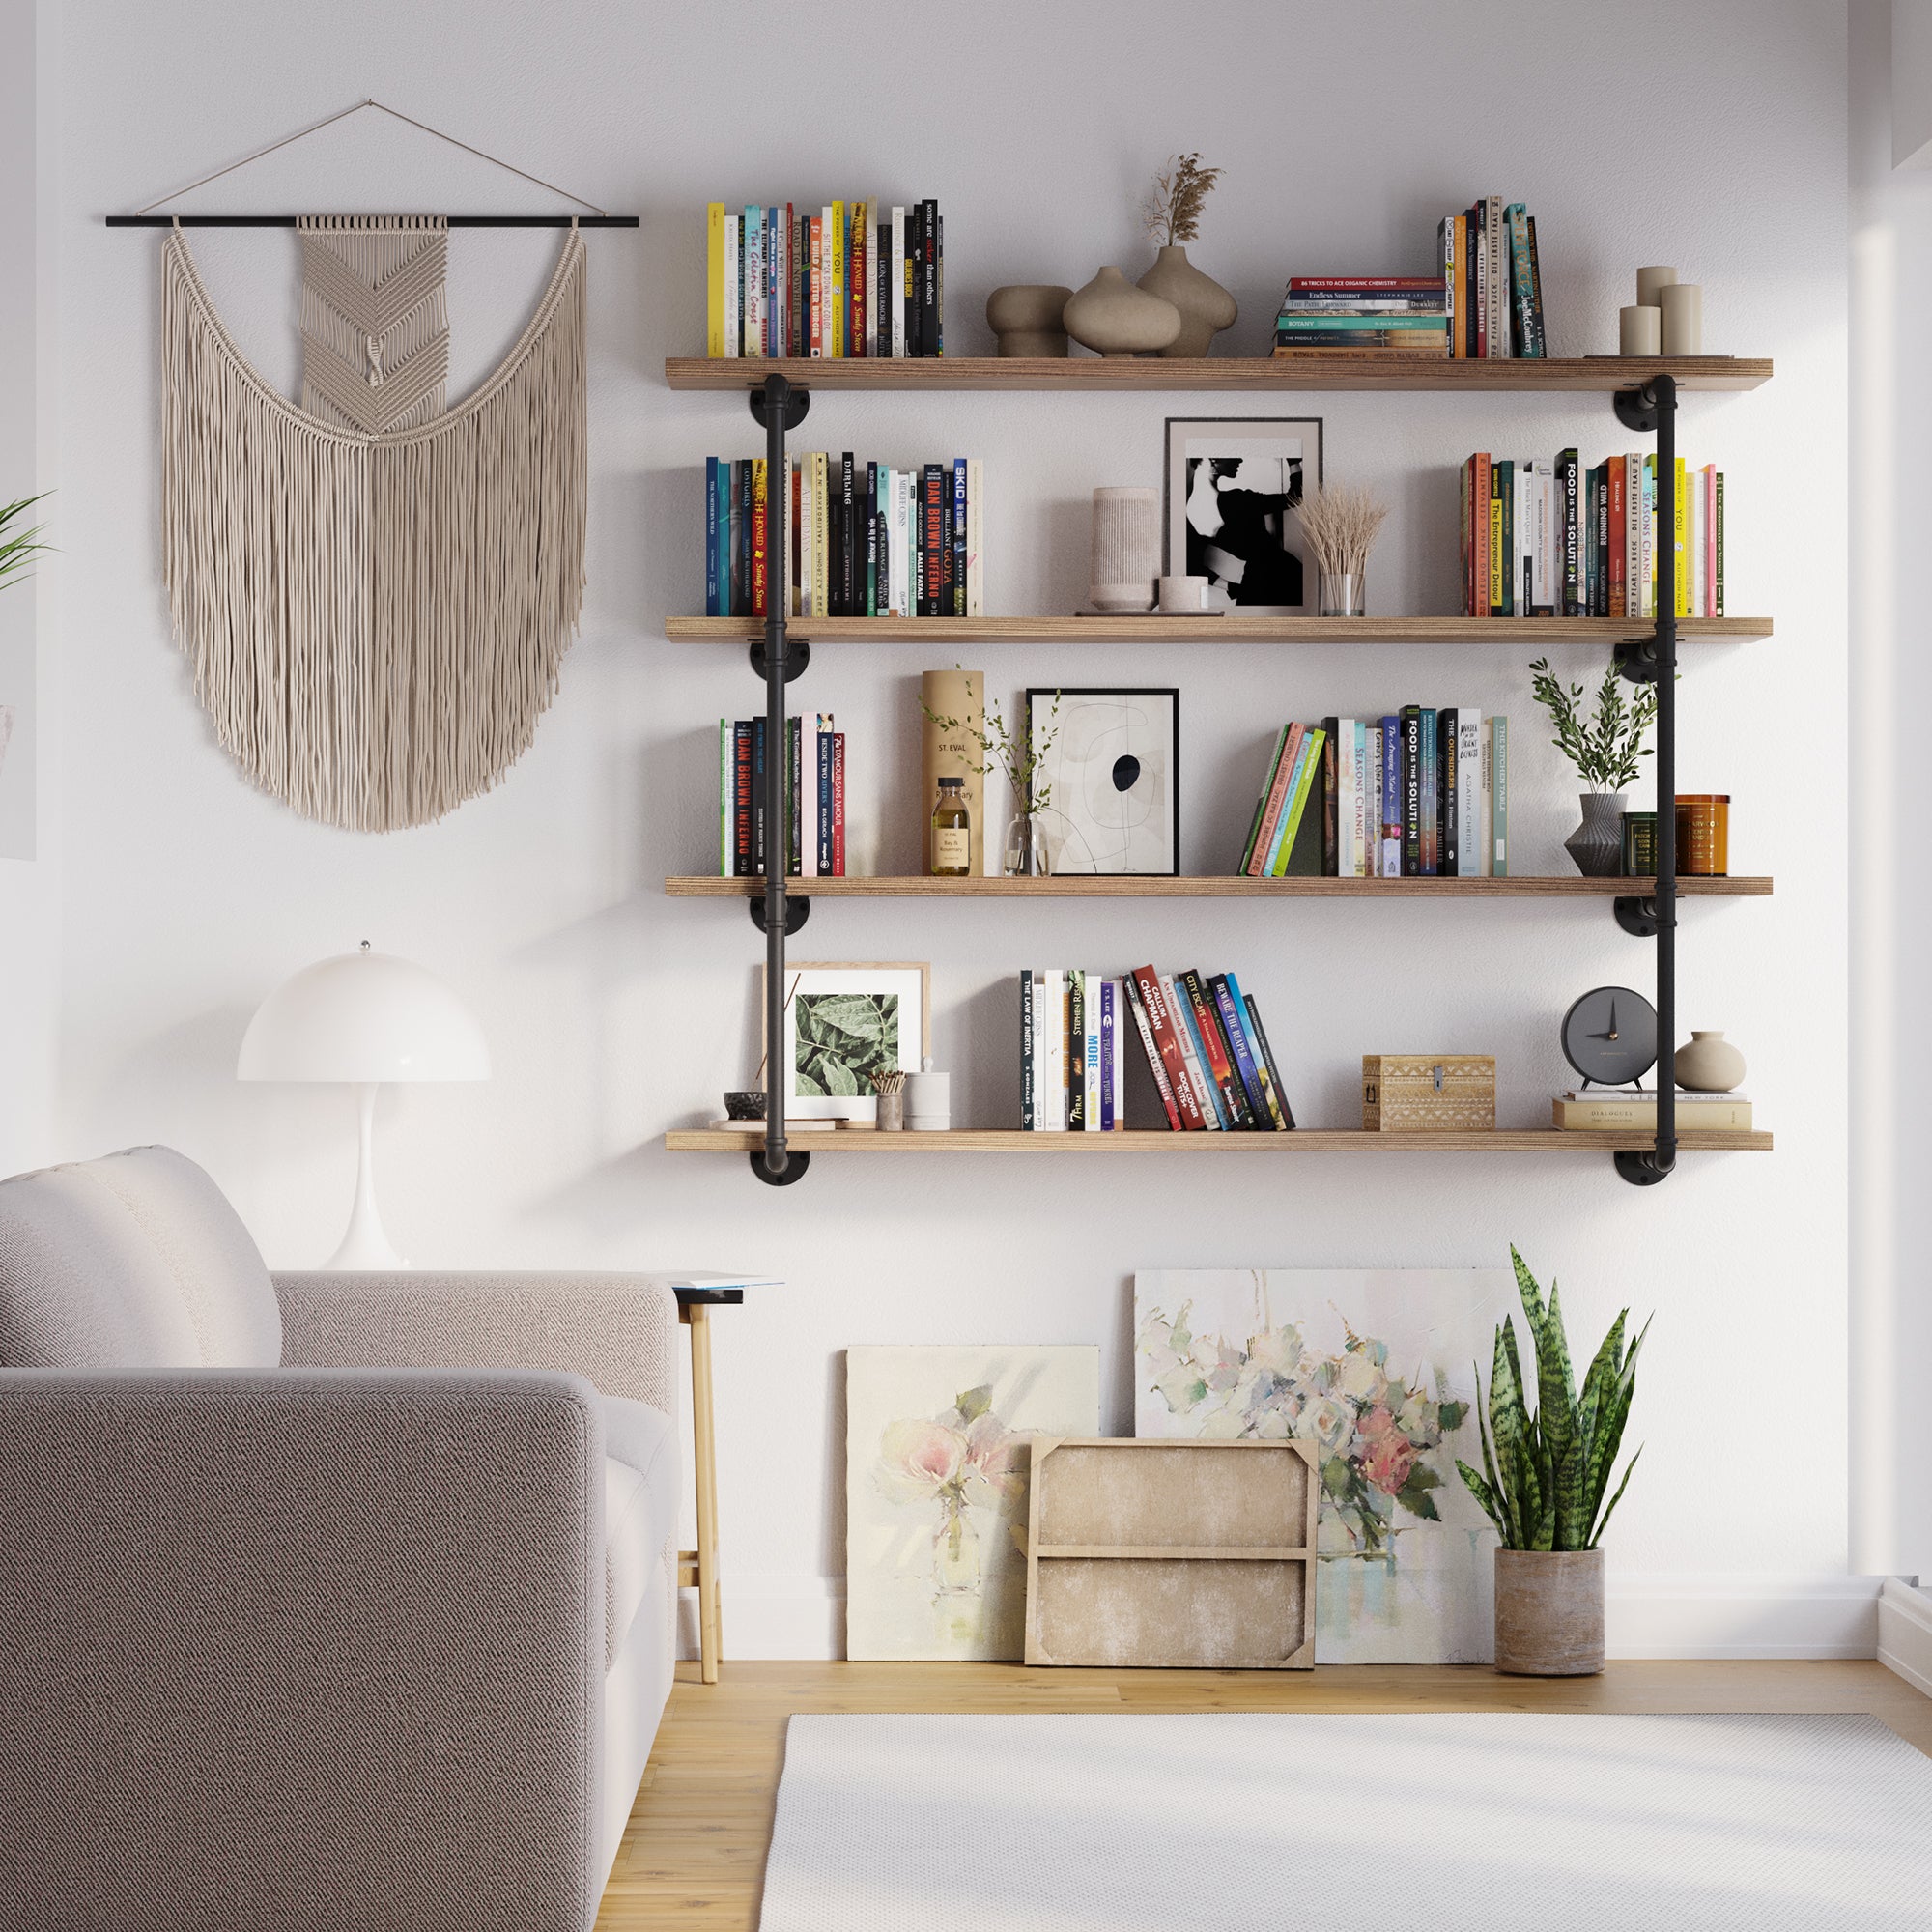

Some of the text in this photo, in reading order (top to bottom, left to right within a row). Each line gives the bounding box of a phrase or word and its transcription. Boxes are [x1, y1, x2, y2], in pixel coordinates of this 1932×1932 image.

[751, 229, 759, 324] The Gelatin Coast
[792, 221, 801, 316] ROAD TO NOWHERE
[867, 231, 876, 296] AFTER DAYS
[853, 306, 863, 352] Sandy Steen
[956, 467, 965, 499] SKID
[802, 489, 810, 553] AFTER DAYS
[927, 481, 940, 598] DAN BROWN INFERNO
[1642, 491, 1651, 584] SEASONS CHANGE
[1492, 504, 1500, 601] The Entrepreneur Detour
[755, 563, 765, 609] Sandy Steen
[1387, 724, 1396, 793] The Avenging Maid
[1409, 720, 1418, 753] FOOD
[738, 738, 751, 855] DAN BROWN INFERNO
[1355, 748, 1364, 840] SEASONS CHANGE
[1024, 1014, 1031, 1025] OF
[1035, 988, 1043, 1037] MIDLIFE CRISIS
[1140, 980, 1163, 1031] CHAPMAN
[1151, 986, 1168, 1018] CALLUM
[1166, 989, 1179, 1028] UNFAMILIAR
[1178, 1026, 1191, 1053] MURDER
[1185, 975, 1207, 1018] CITY ESCAPE
[1216, 982, 1248, 1060] BEWARE THE REAPER
[1088, 1035, 1098, 1068] MORE
[1176, 1085, 1187, 1108] TUTS+
[1179, 1071, 1200, 1119] BOOK COVER
[1223, 1085, 1240, 1122] Theresa Shaver
